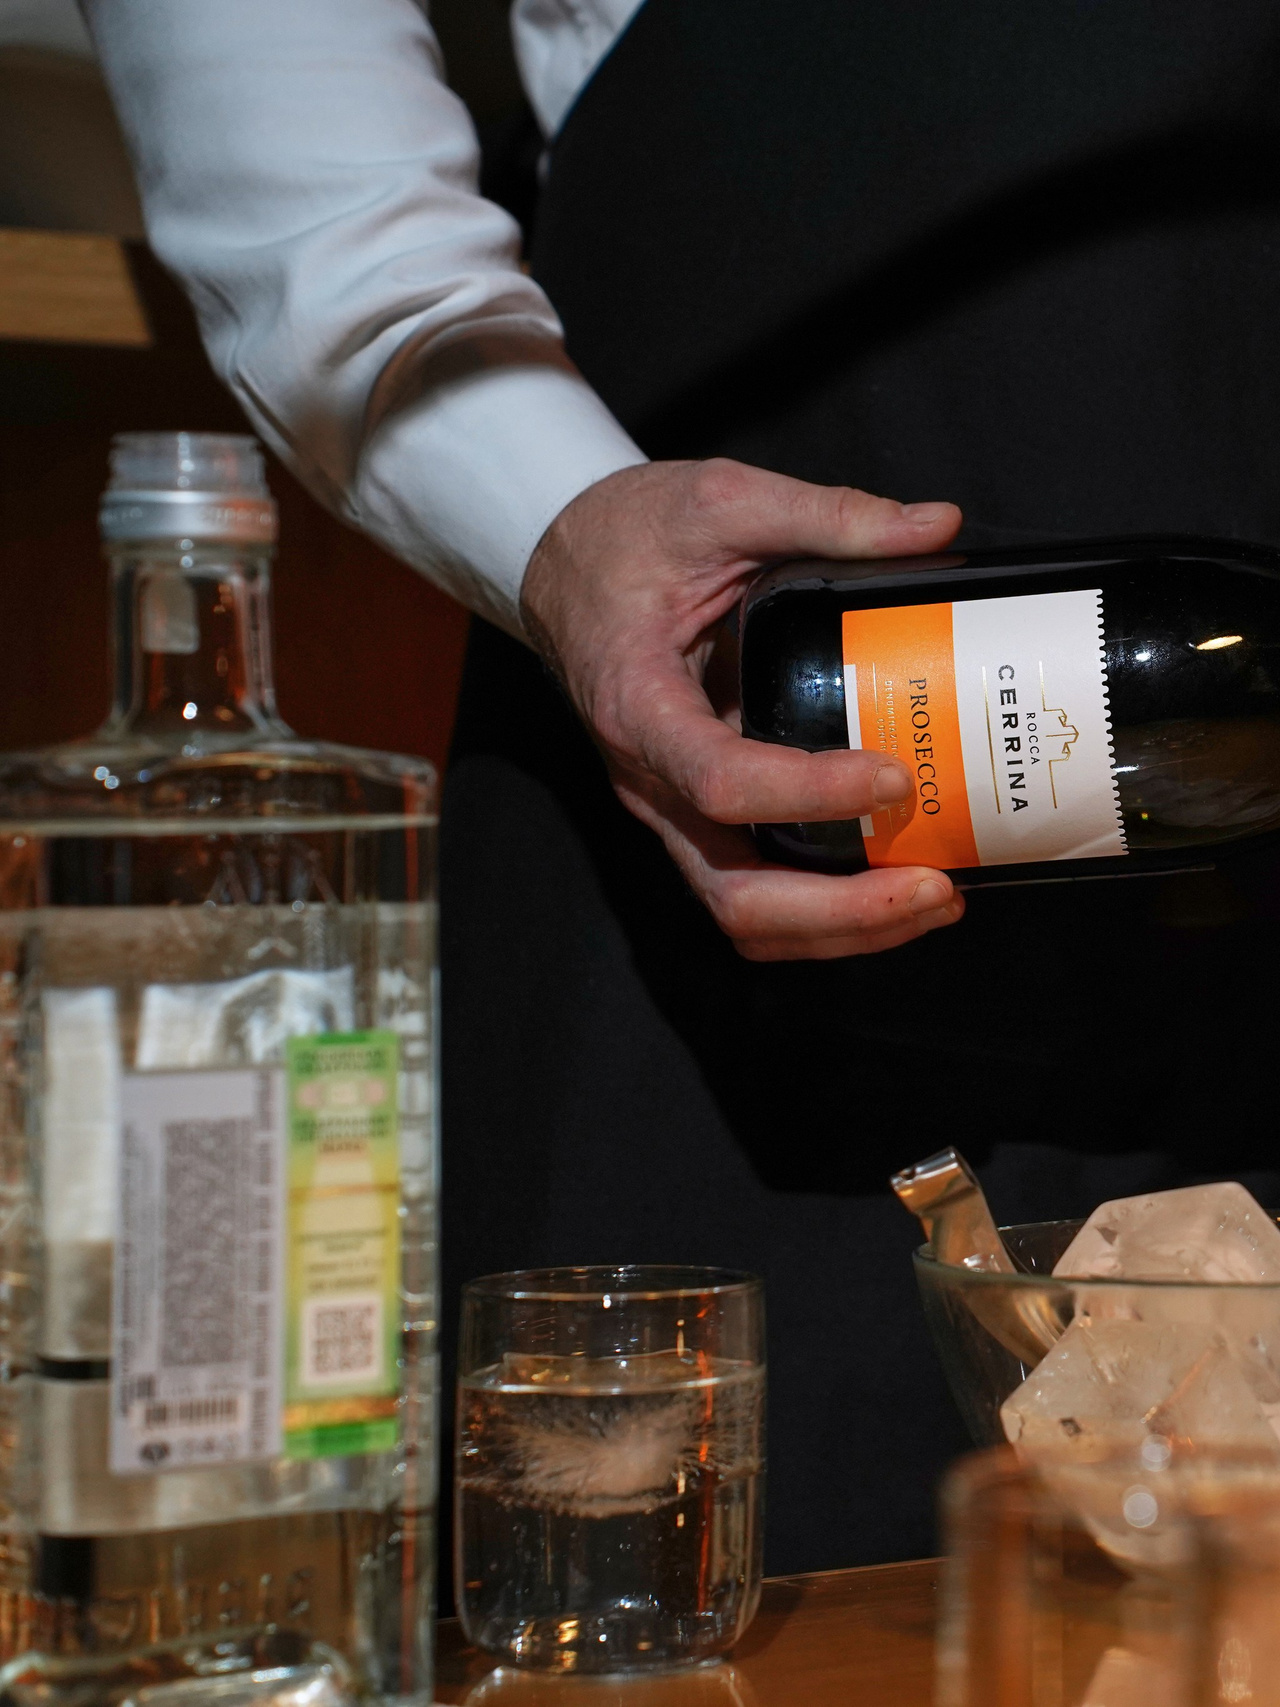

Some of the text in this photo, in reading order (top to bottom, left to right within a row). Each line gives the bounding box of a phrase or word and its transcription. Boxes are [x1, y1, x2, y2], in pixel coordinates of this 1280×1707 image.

[885, 680, 899, 758] DENOMINAZION
[909, 678, 941, 815] PROSECCO
[998, 664, 1029, 812] CERRINA
[1026, 712, 1040, 765] ROCCA
